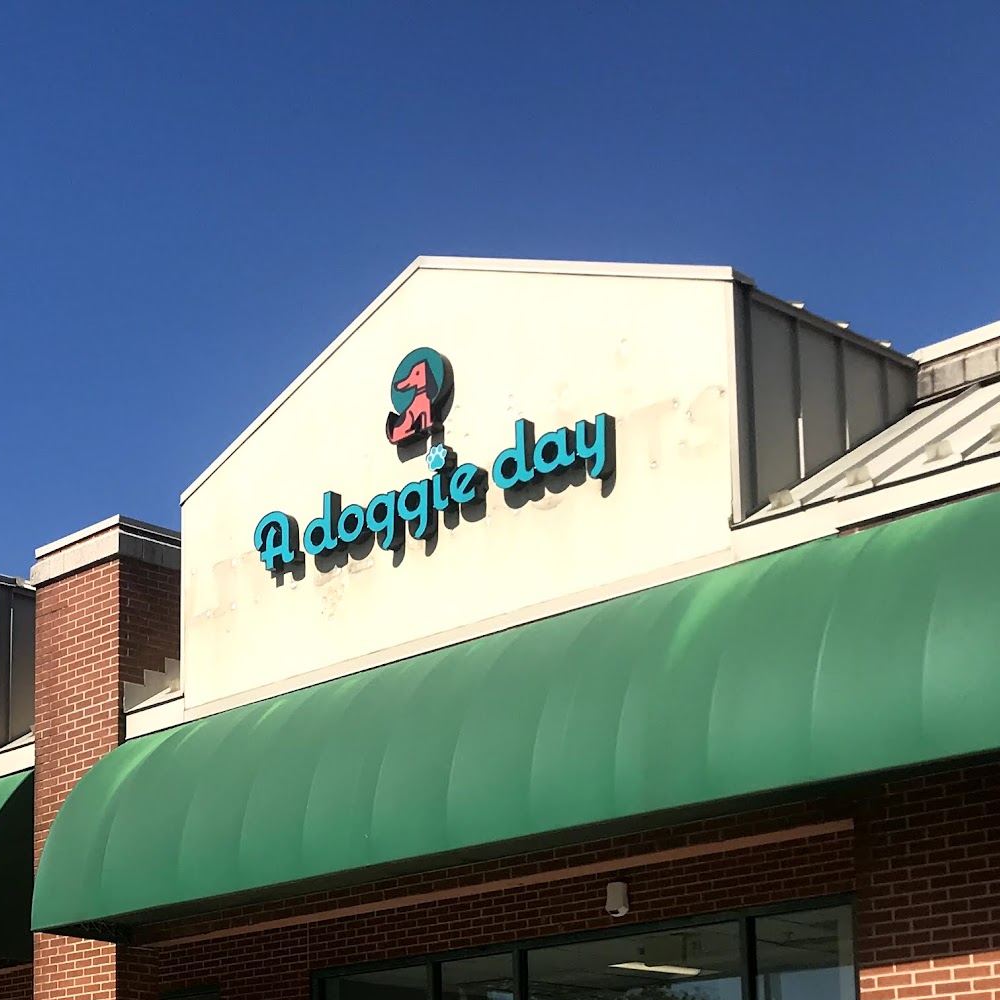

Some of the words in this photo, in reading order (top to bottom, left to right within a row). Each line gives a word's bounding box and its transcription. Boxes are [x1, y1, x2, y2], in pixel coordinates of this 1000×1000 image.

[254, 511, 297, 571] A
[303, 443, 483, 555] doggie
[492, 412, 611, 490] day
